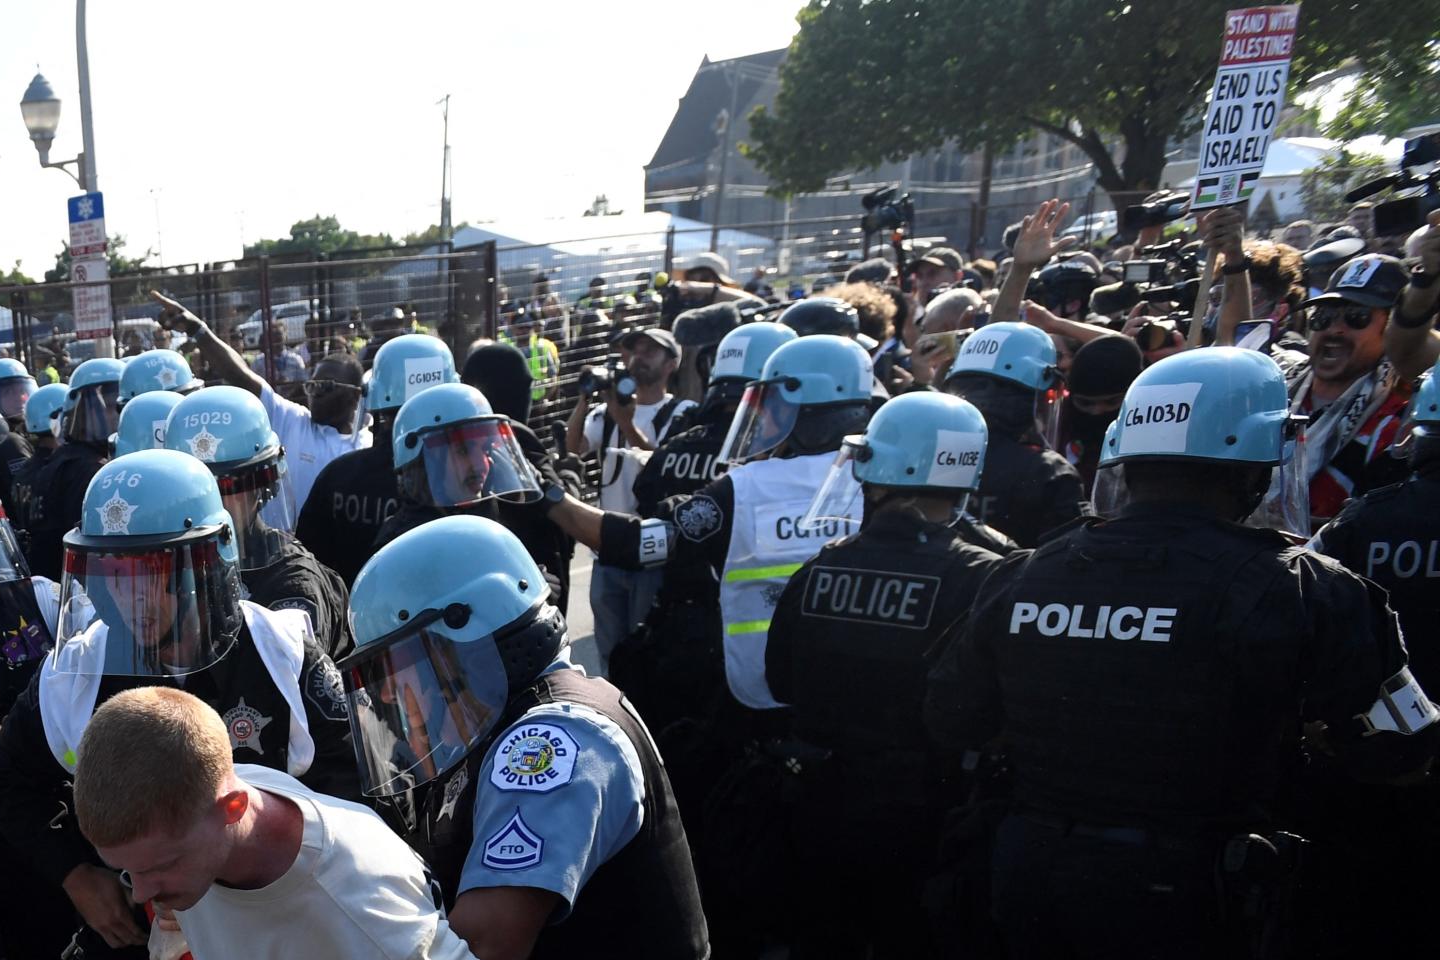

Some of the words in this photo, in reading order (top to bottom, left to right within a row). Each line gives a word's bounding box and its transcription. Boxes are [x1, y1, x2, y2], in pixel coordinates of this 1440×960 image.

[1227, 14, 1265, 35] STAND
[1269, 12, 1296, 31] WITH
[1223, 33, 1293, 61] PALESTINE!
[1216, 73, 1250, 100] END
[1208, 105, 1243, 136] AID
[1251, 101, 1275, 131] TO
[1204, 135, 1269, 168] ISRAEL!
[183, 411, 232, 428] 15029
[1125, 402, 1191, 426] CG103D
[102, 470, 142, 489] 546
[643, 534, 656, 555] 101
[811, 572, 926, 621] POLICE
[1009, 602, 1177, 642] POLICE
[502, 728, 567, 757] CHICAGO
[499, 766, 559, 786] POLICE
[500, 845, 524, 854] FTO
